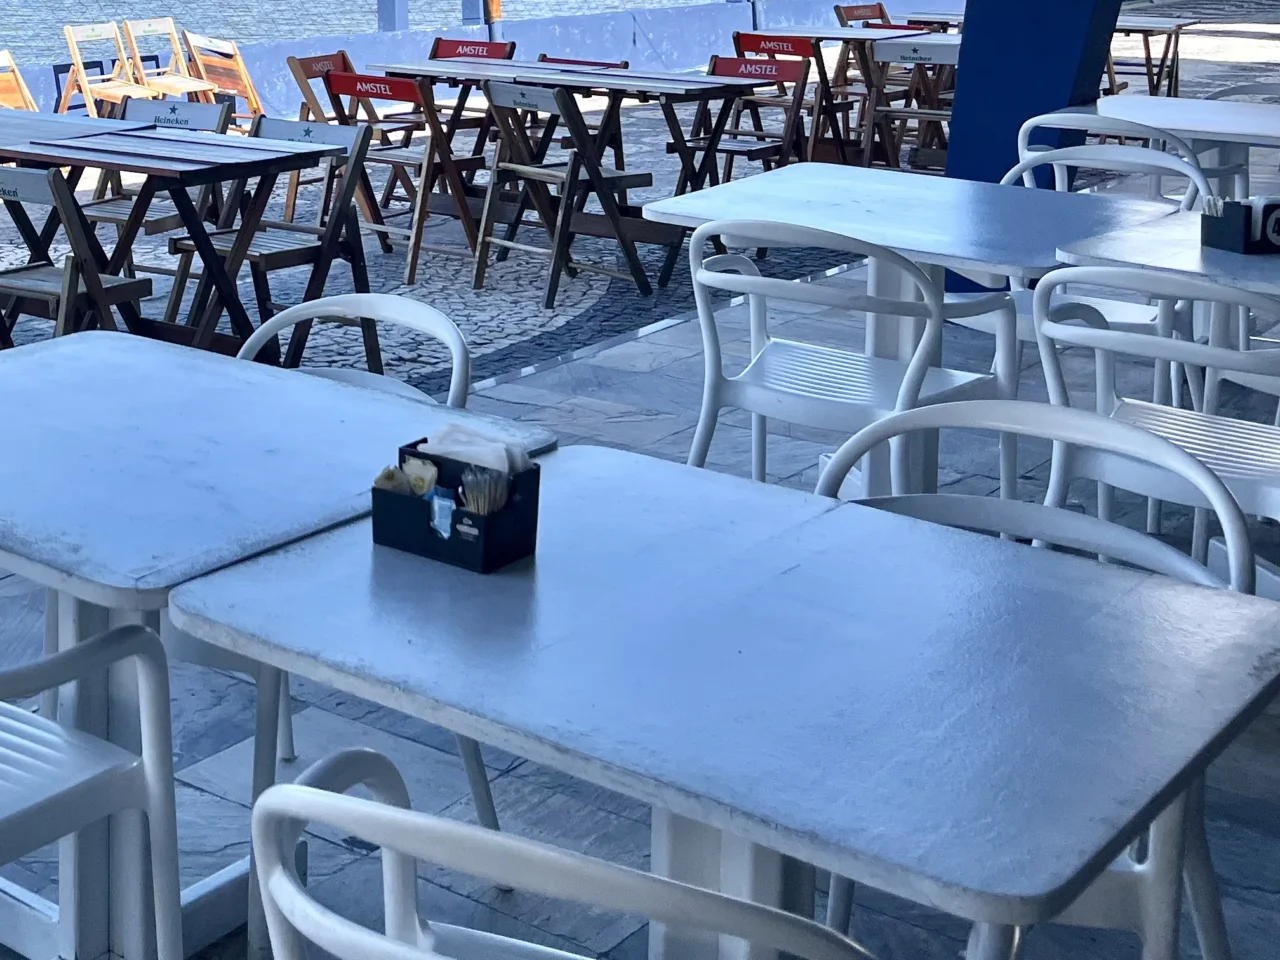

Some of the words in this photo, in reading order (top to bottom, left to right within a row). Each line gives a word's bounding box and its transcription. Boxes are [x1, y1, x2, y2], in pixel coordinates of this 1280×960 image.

[456, 45, 488, 56] AMSTEL
[760, 41, 794, 52] AMSTEL
[312, 60, 336, 72] AMSTEL
[739, 63, 778, 75] AMSTEL
[356, 82, 392, 95] AMSTEL
[154, 115, 189, 125] Heineken
